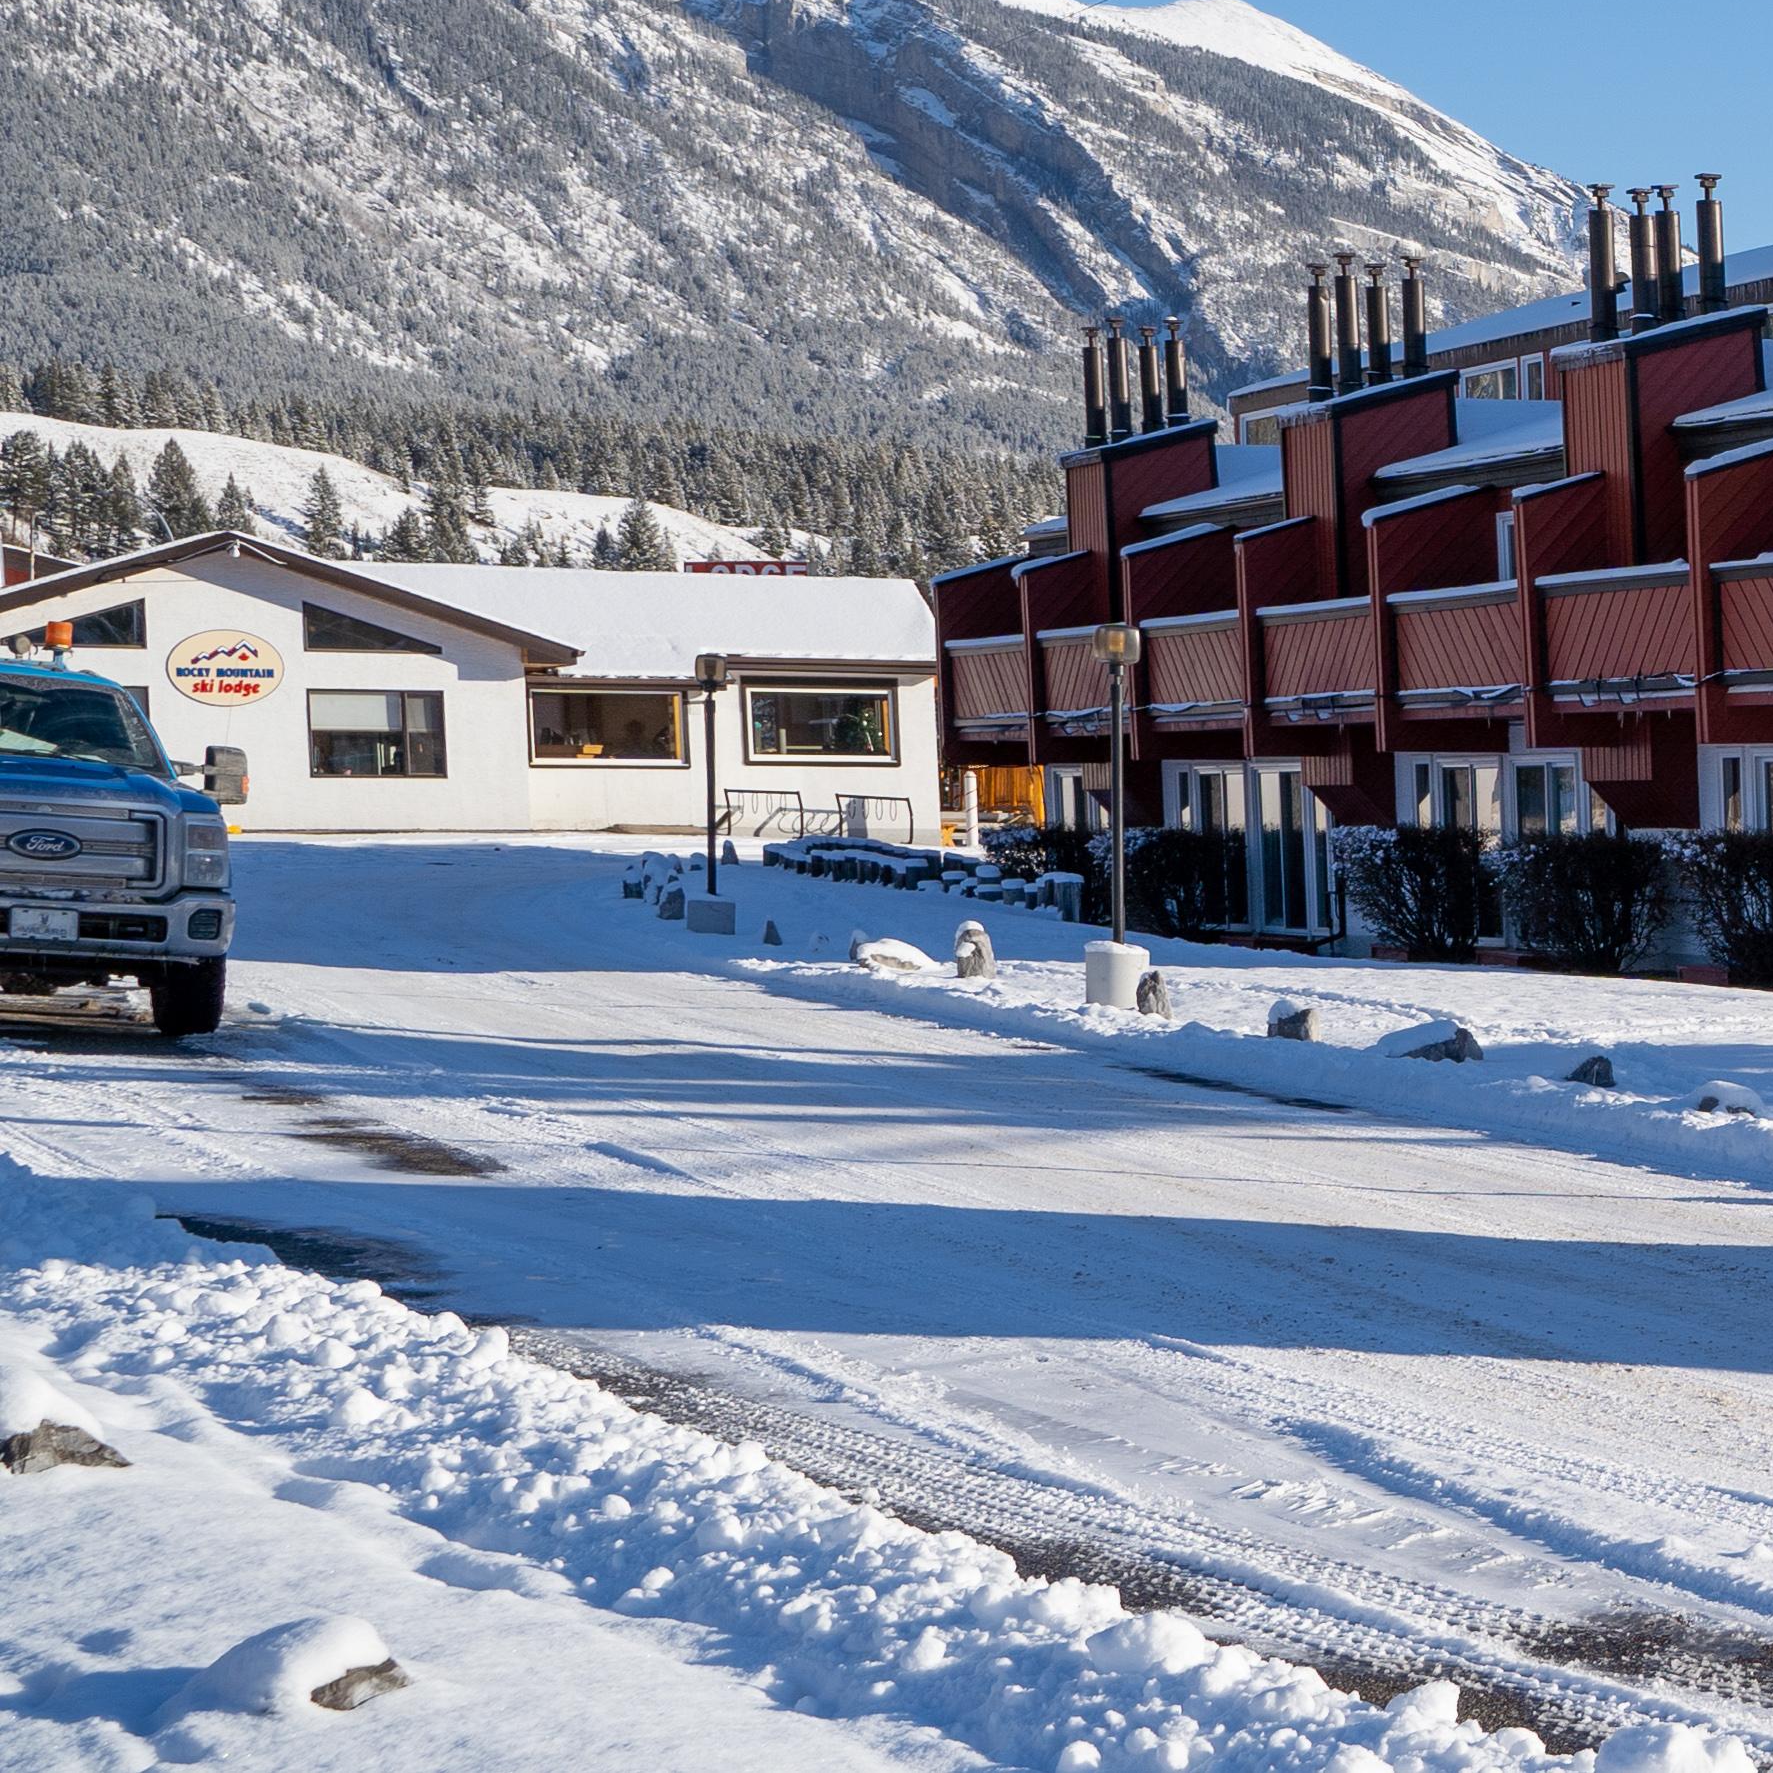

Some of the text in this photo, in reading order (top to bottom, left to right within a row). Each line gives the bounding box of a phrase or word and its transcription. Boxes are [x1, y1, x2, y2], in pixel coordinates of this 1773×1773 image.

[176, 667, 274, 678] ROCKY MOUNTAIN
[192, 679, 261, 697] ski lodge
[26, 835, 65, 852] Ford
